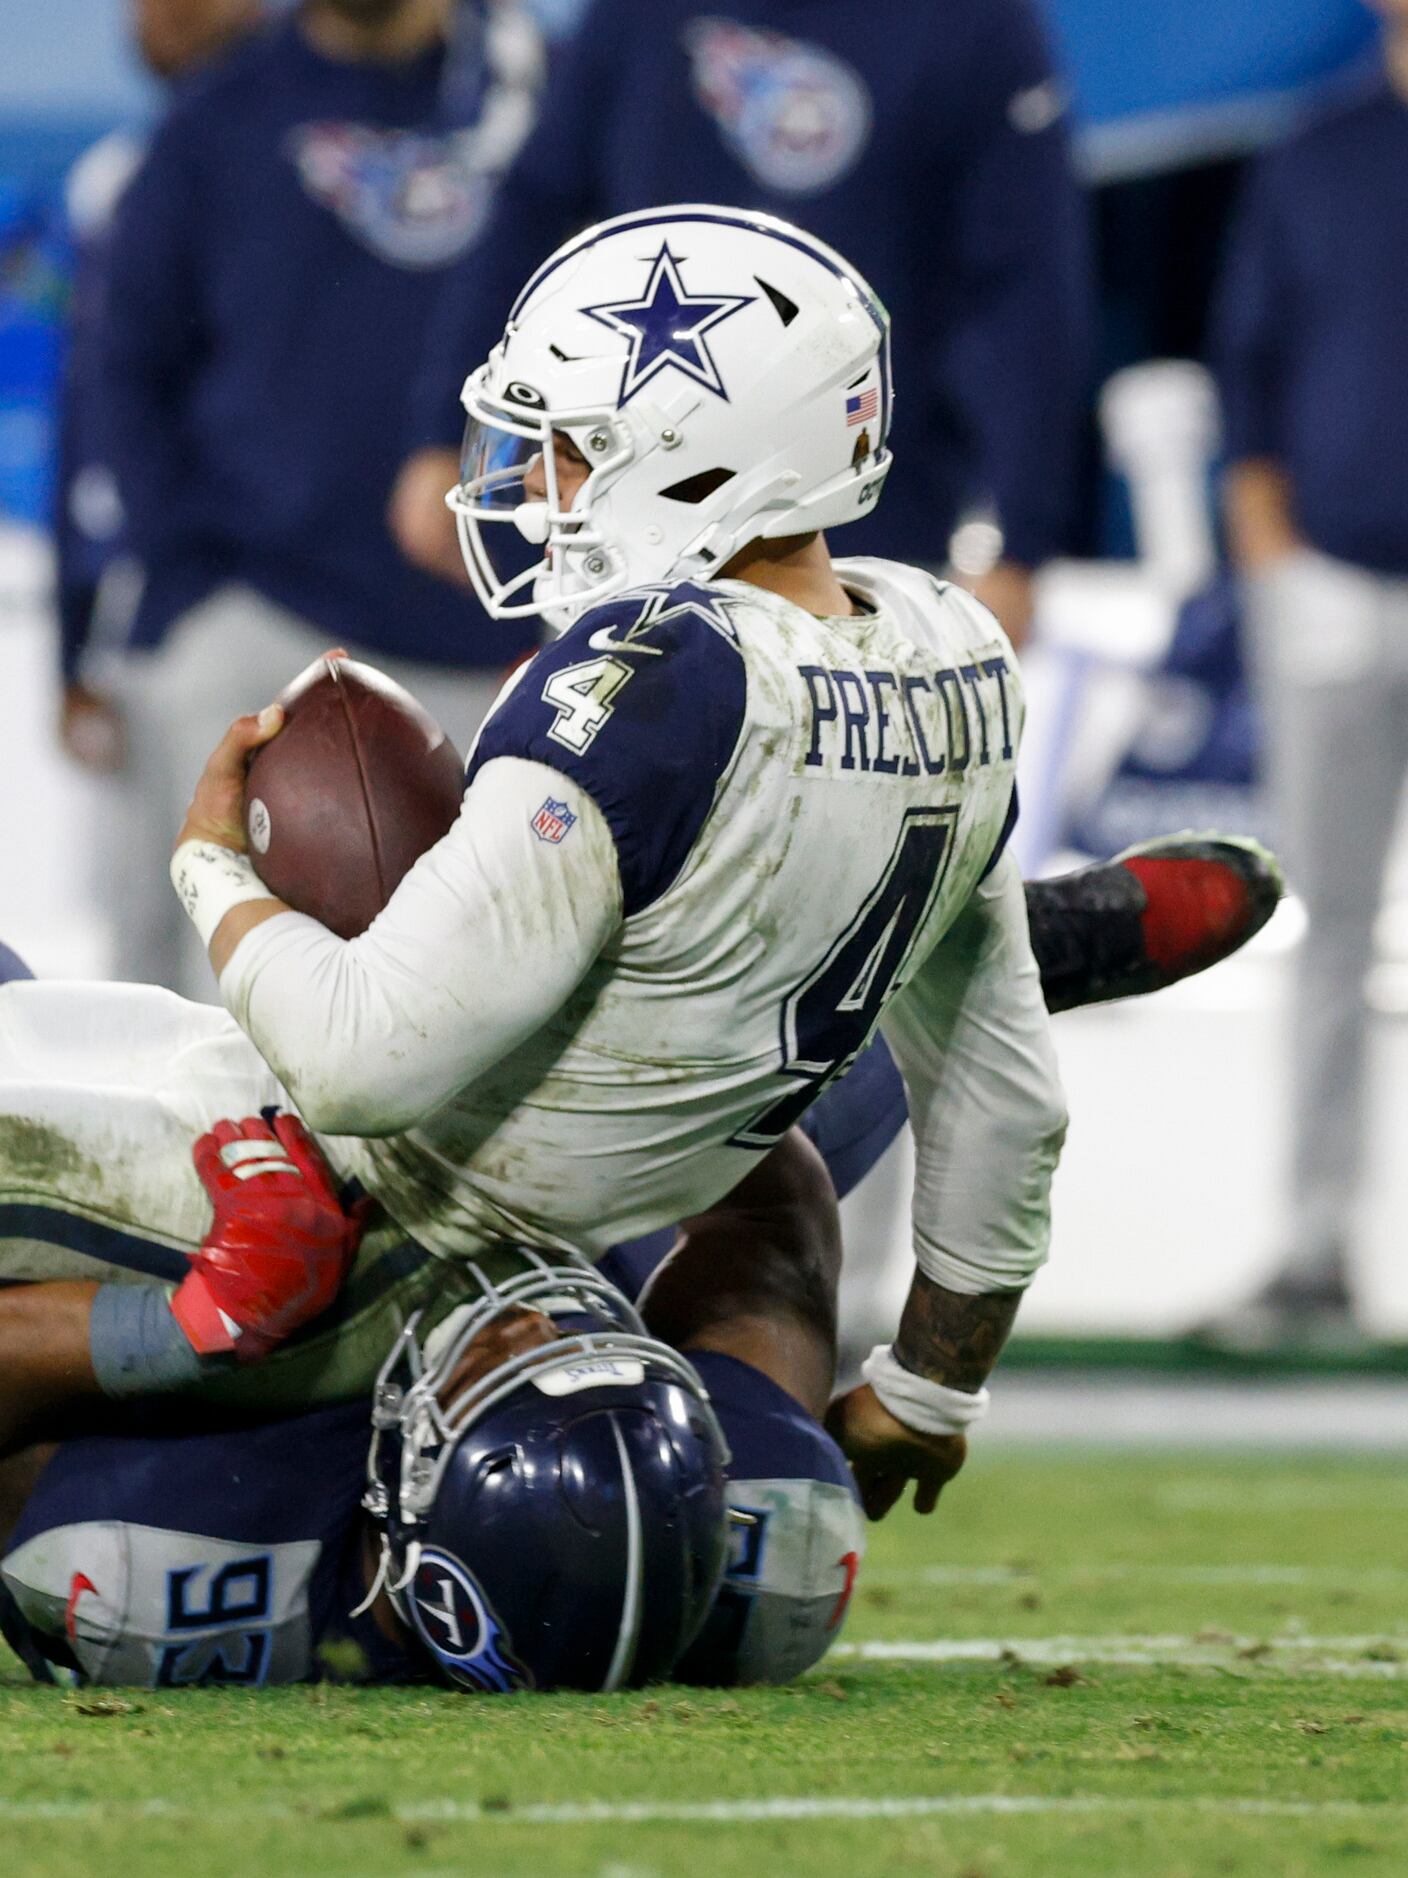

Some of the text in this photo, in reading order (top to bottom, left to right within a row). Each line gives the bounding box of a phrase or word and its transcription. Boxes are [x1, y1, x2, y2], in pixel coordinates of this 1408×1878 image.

[541, 654, 635, 757] 4
[796, 657, 1010, 776] PRESCOTT
[534, 810, 563, 840] NFL
[724, 804, 961, 1151] 4
[148, 1552, 274, 1690] 93
